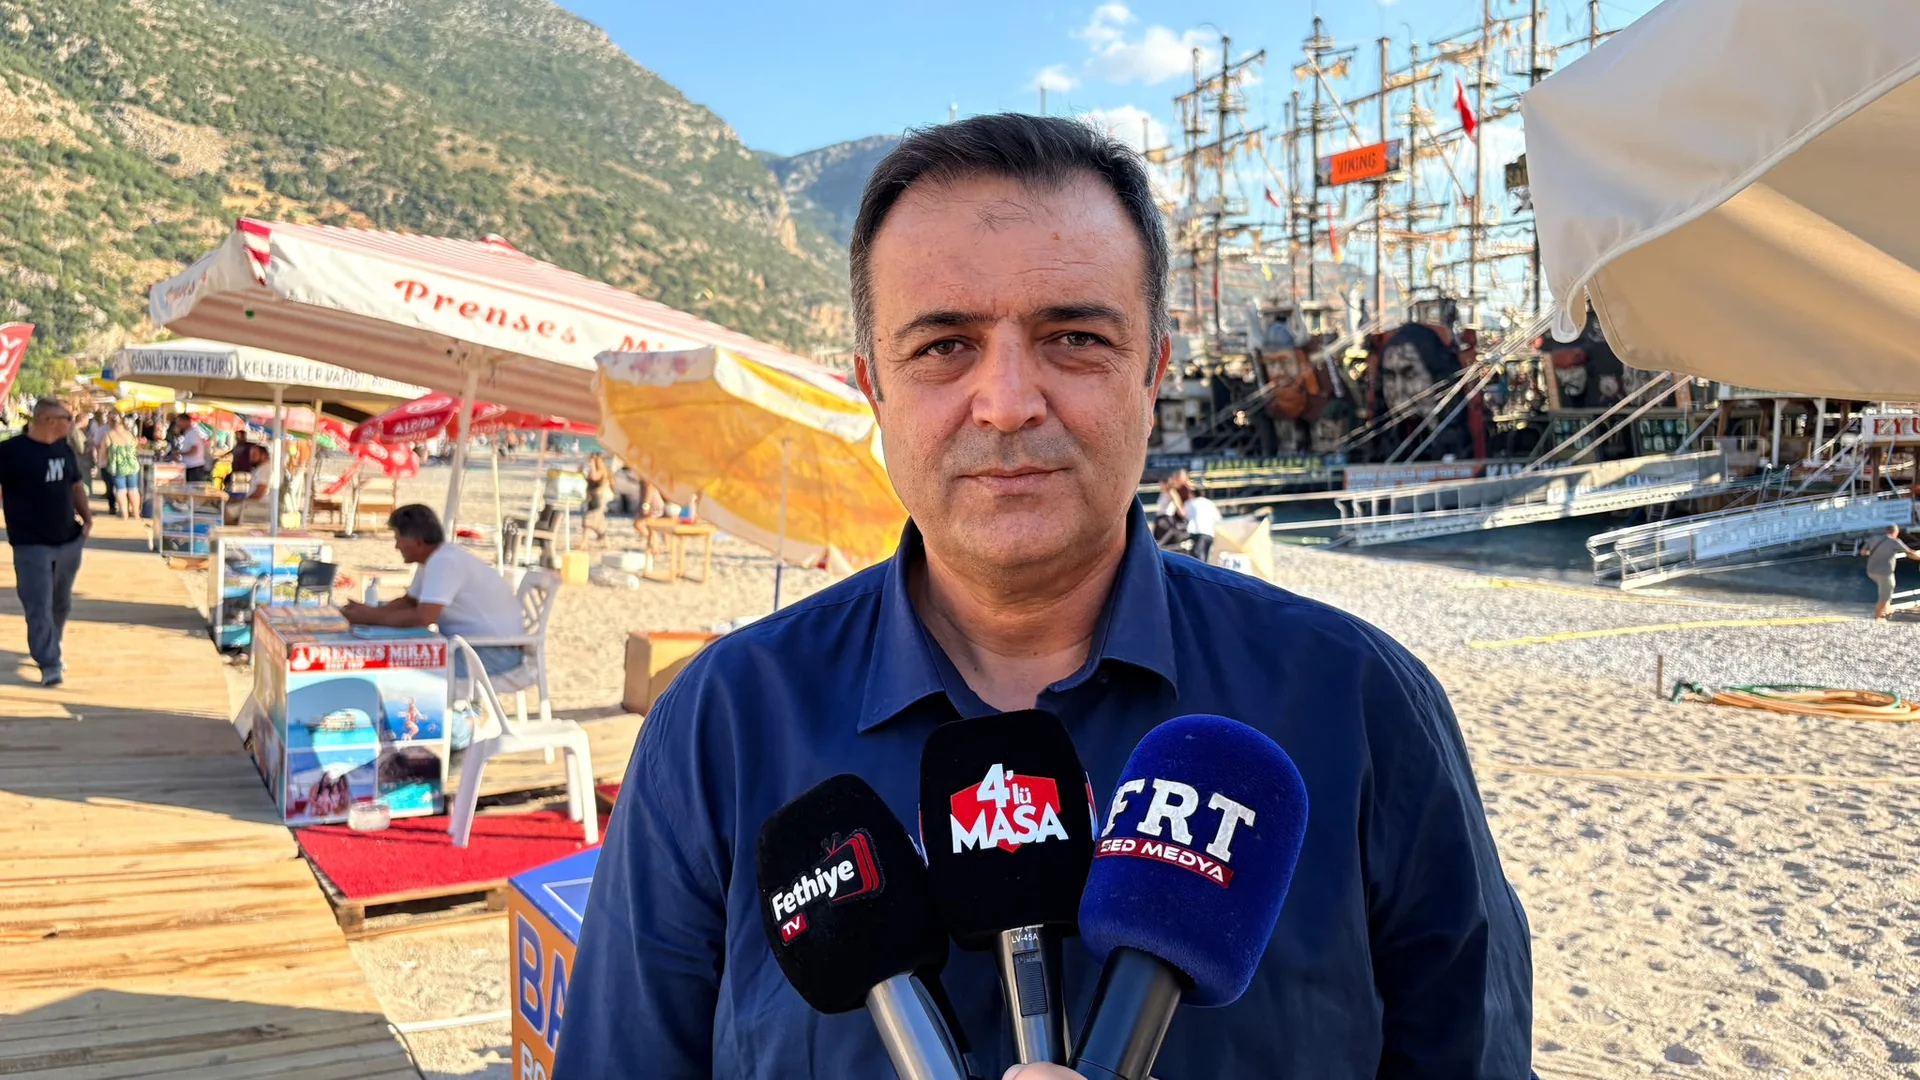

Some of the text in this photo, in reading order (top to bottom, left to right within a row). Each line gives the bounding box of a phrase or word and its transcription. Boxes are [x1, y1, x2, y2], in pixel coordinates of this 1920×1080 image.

[394, 279, 577, 345] Prenses
[131, 349, 170, 371] GÜNLÜK
[172, 355, 204, 374] TEKNE
[308, 644, 386, 664] PRENSES
[950, 802, 1069, 853] MASA
[1101, 778, 1256, 863] FRT
[1141, 842, 1224, 882] MEDYA
[772, 860, 855, 921] Fethiye
[783, 915, 800, 935] TV
[1011, 932, 1039, 944] LV-45A
